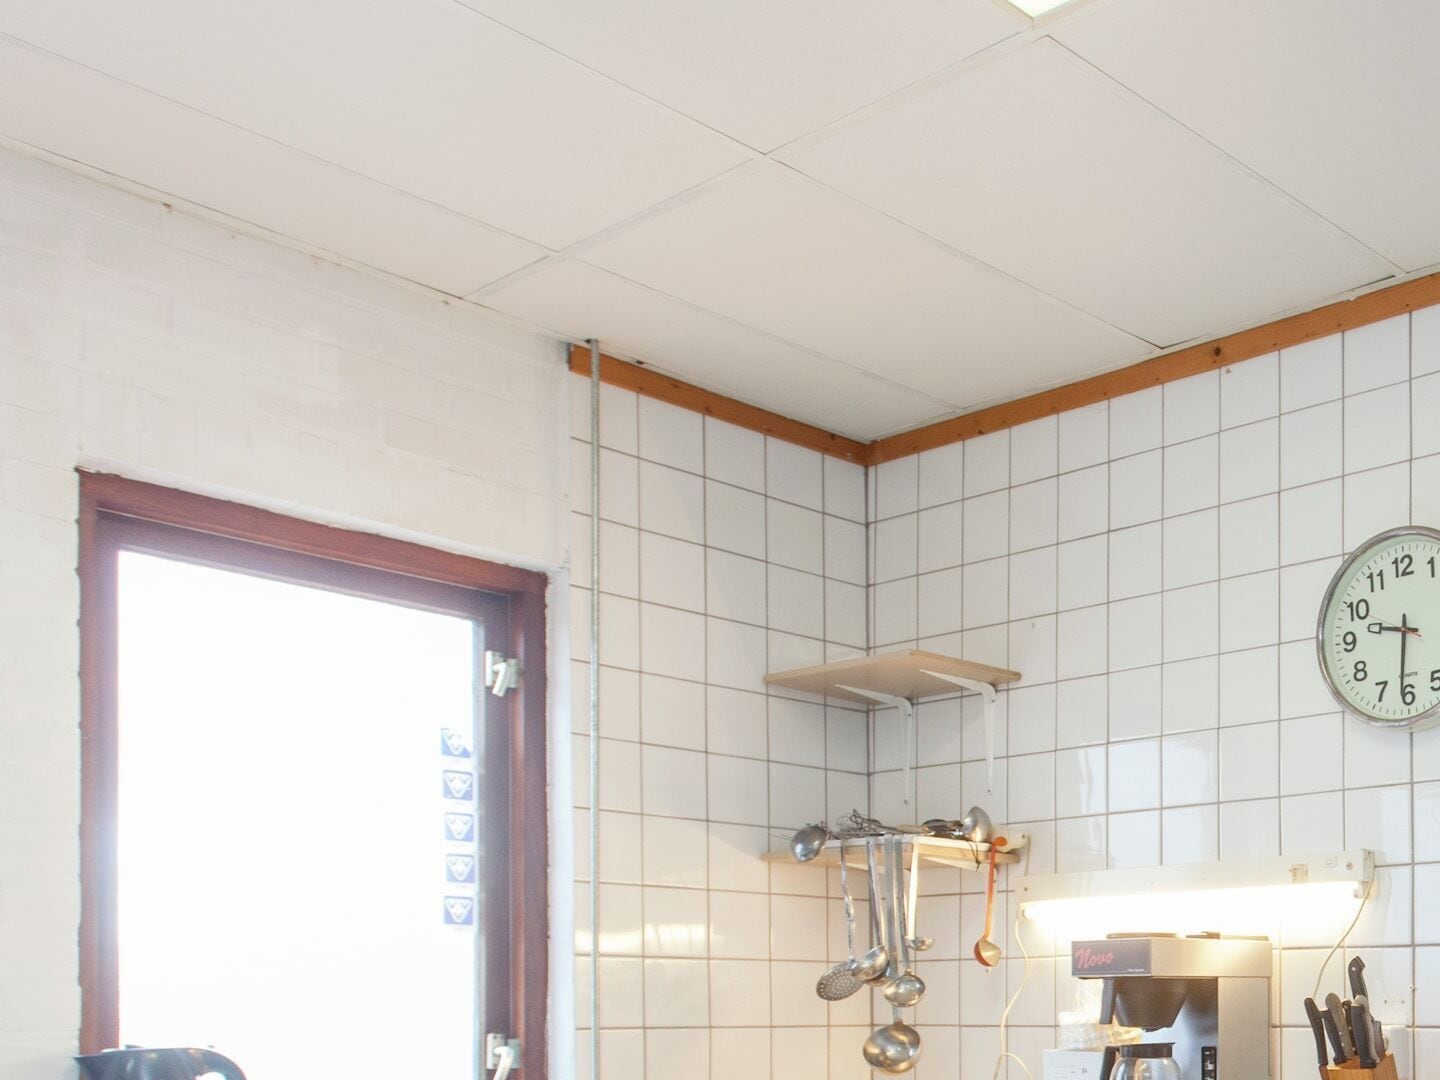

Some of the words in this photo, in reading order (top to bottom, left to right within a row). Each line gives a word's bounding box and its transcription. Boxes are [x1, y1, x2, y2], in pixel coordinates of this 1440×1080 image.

[1391, 554, 1415, 579] 12
[1426, 556, 1436, 578] 1
[1366, 569, 1385, 593] 11
[1346, 598, 1370, 622] 10
[1342, 631, 1357, 653] 9
[1353, 660, 1368, 682] 8
[1374, 680, 1389, 703] 7
[1401, 683, 1416, 706] 6
[1075, 948, 1115, 969] Novo
